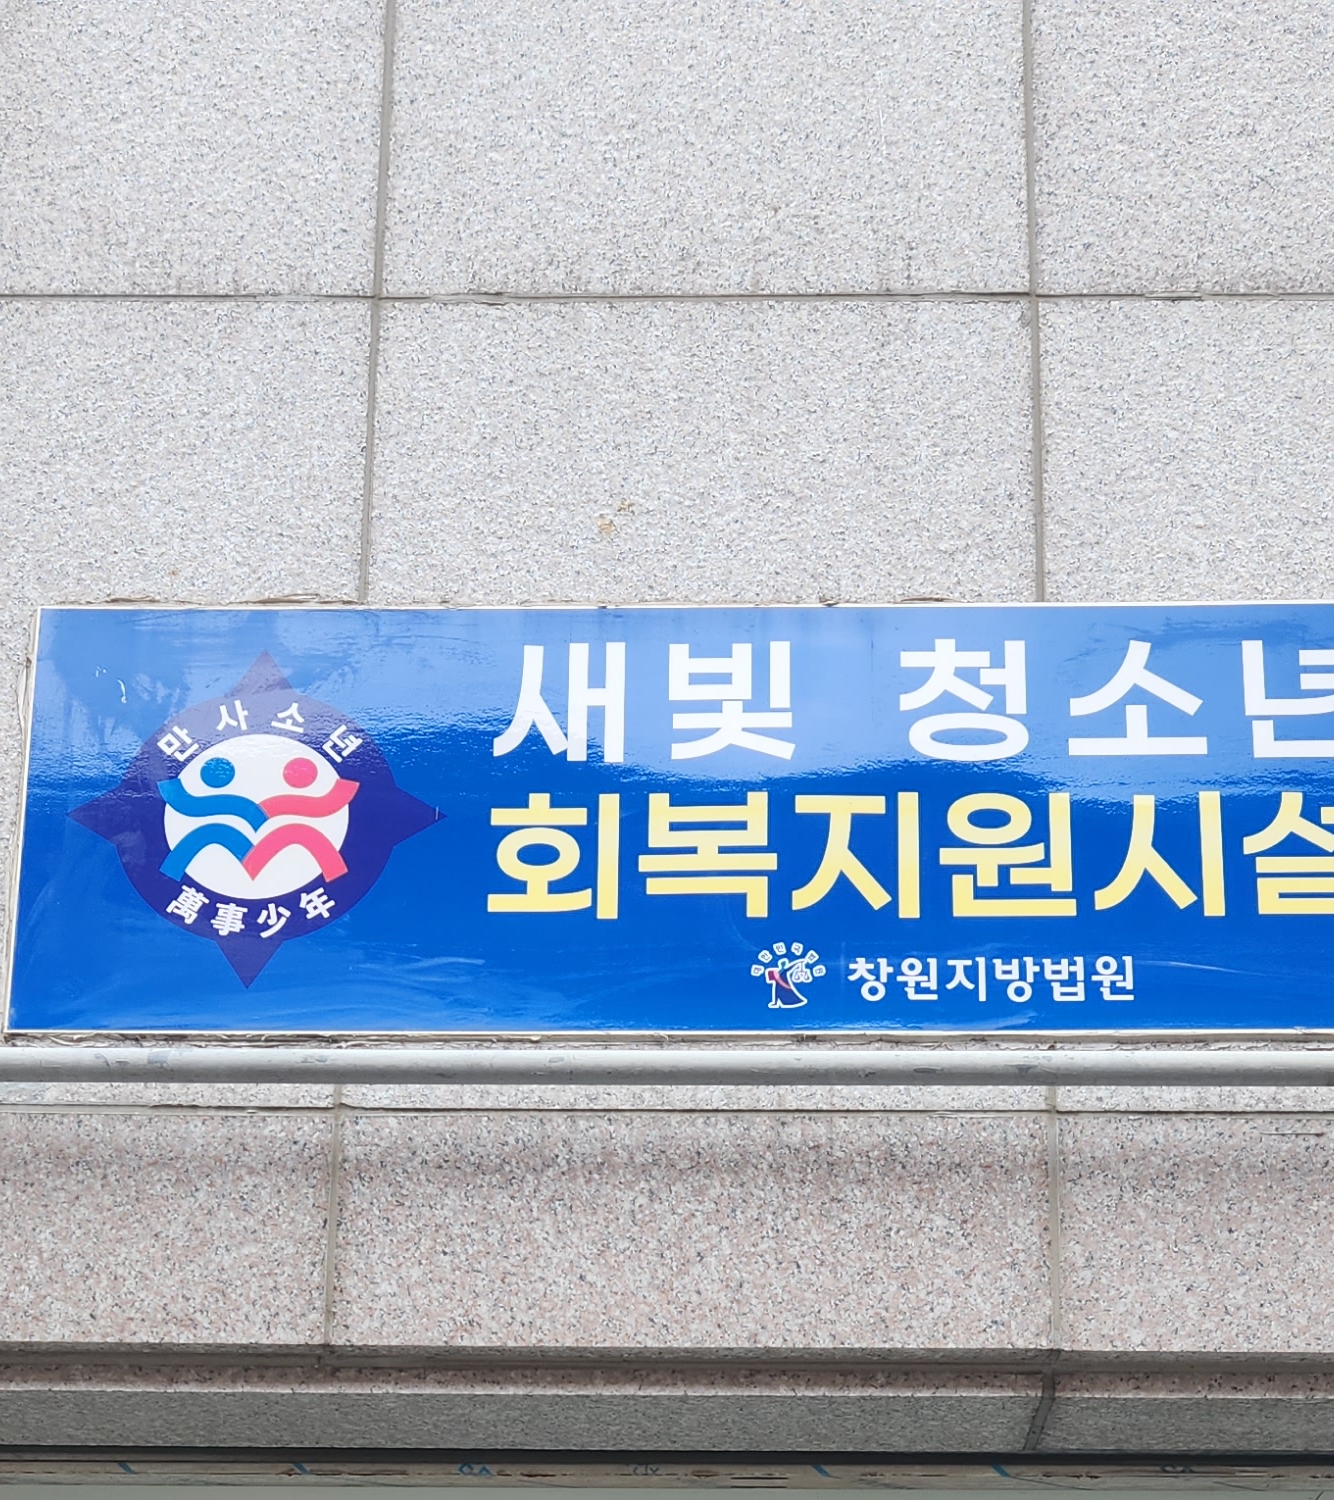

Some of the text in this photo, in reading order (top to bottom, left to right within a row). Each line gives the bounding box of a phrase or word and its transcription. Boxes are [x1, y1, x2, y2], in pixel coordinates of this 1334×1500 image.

[156, 700, 363, 763] 만사소년
[493, 641, 796, 763] 새빛
[847, 955, 1135, 1002] 창원지방법원
